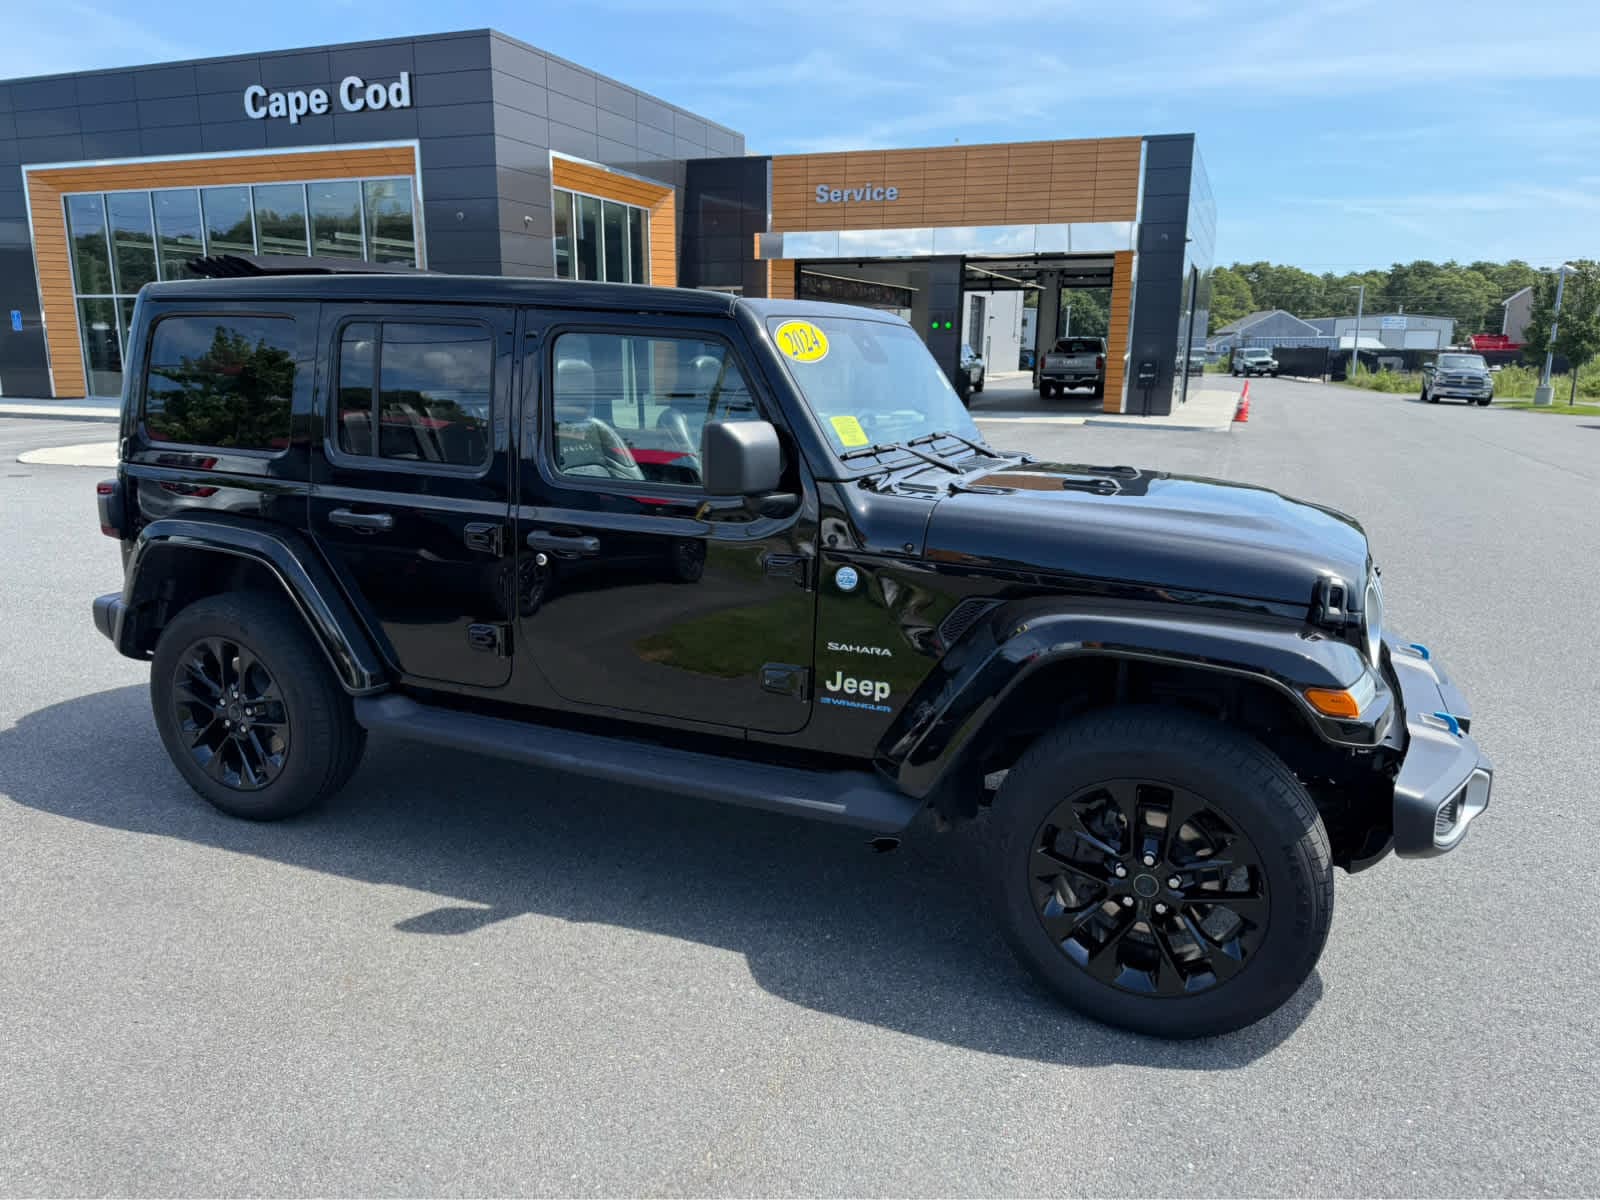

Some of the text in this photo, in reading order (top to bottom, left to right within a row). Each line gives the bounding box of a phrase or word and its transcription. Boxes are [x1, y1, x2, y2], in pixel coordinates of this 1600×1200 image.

[244, 71, 412, 124] Cape Cod
[815, 182, 899, 204] Service
[783, 326, 822, 356] 2024
[827, 642, 892, 657] SAHARA
[825, 671, 891, 702] Jeep
